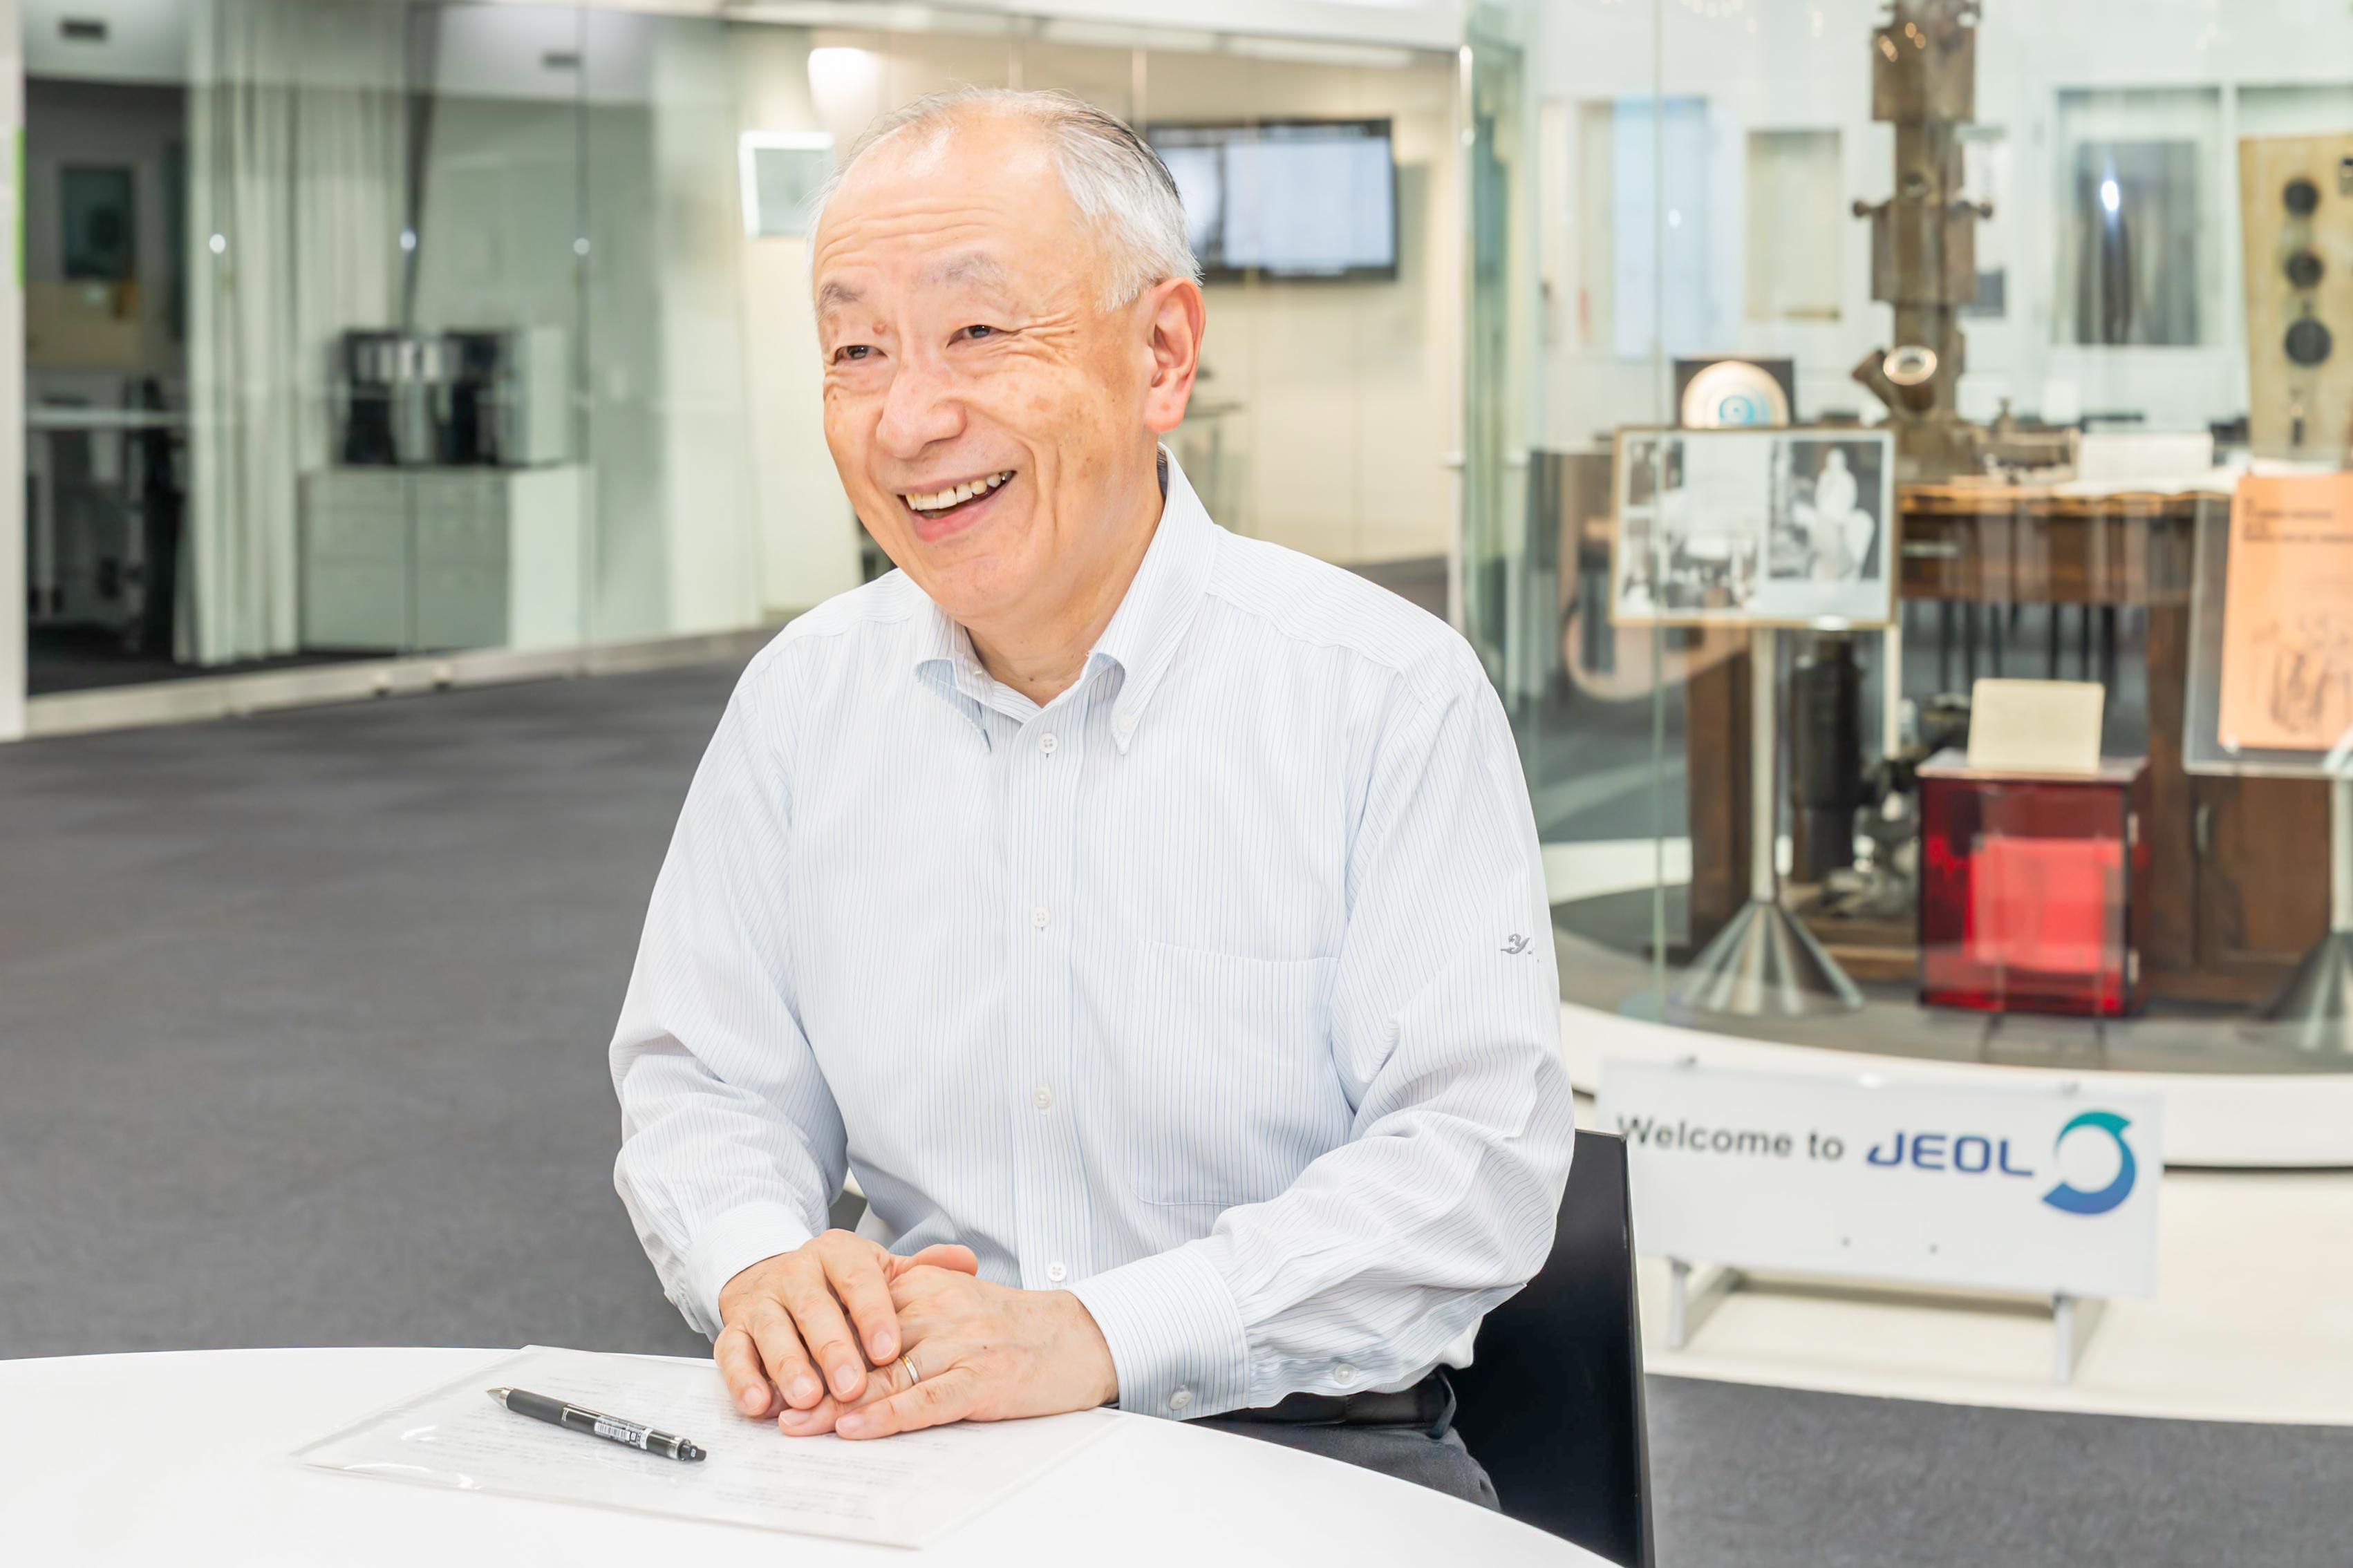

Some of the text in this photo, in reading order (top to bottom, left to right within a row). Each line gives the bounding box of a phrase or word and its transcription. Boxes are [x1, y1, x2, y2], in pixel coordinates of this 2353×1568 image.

[1616, 1115, 2035, 1178] Welcome to JEOL
